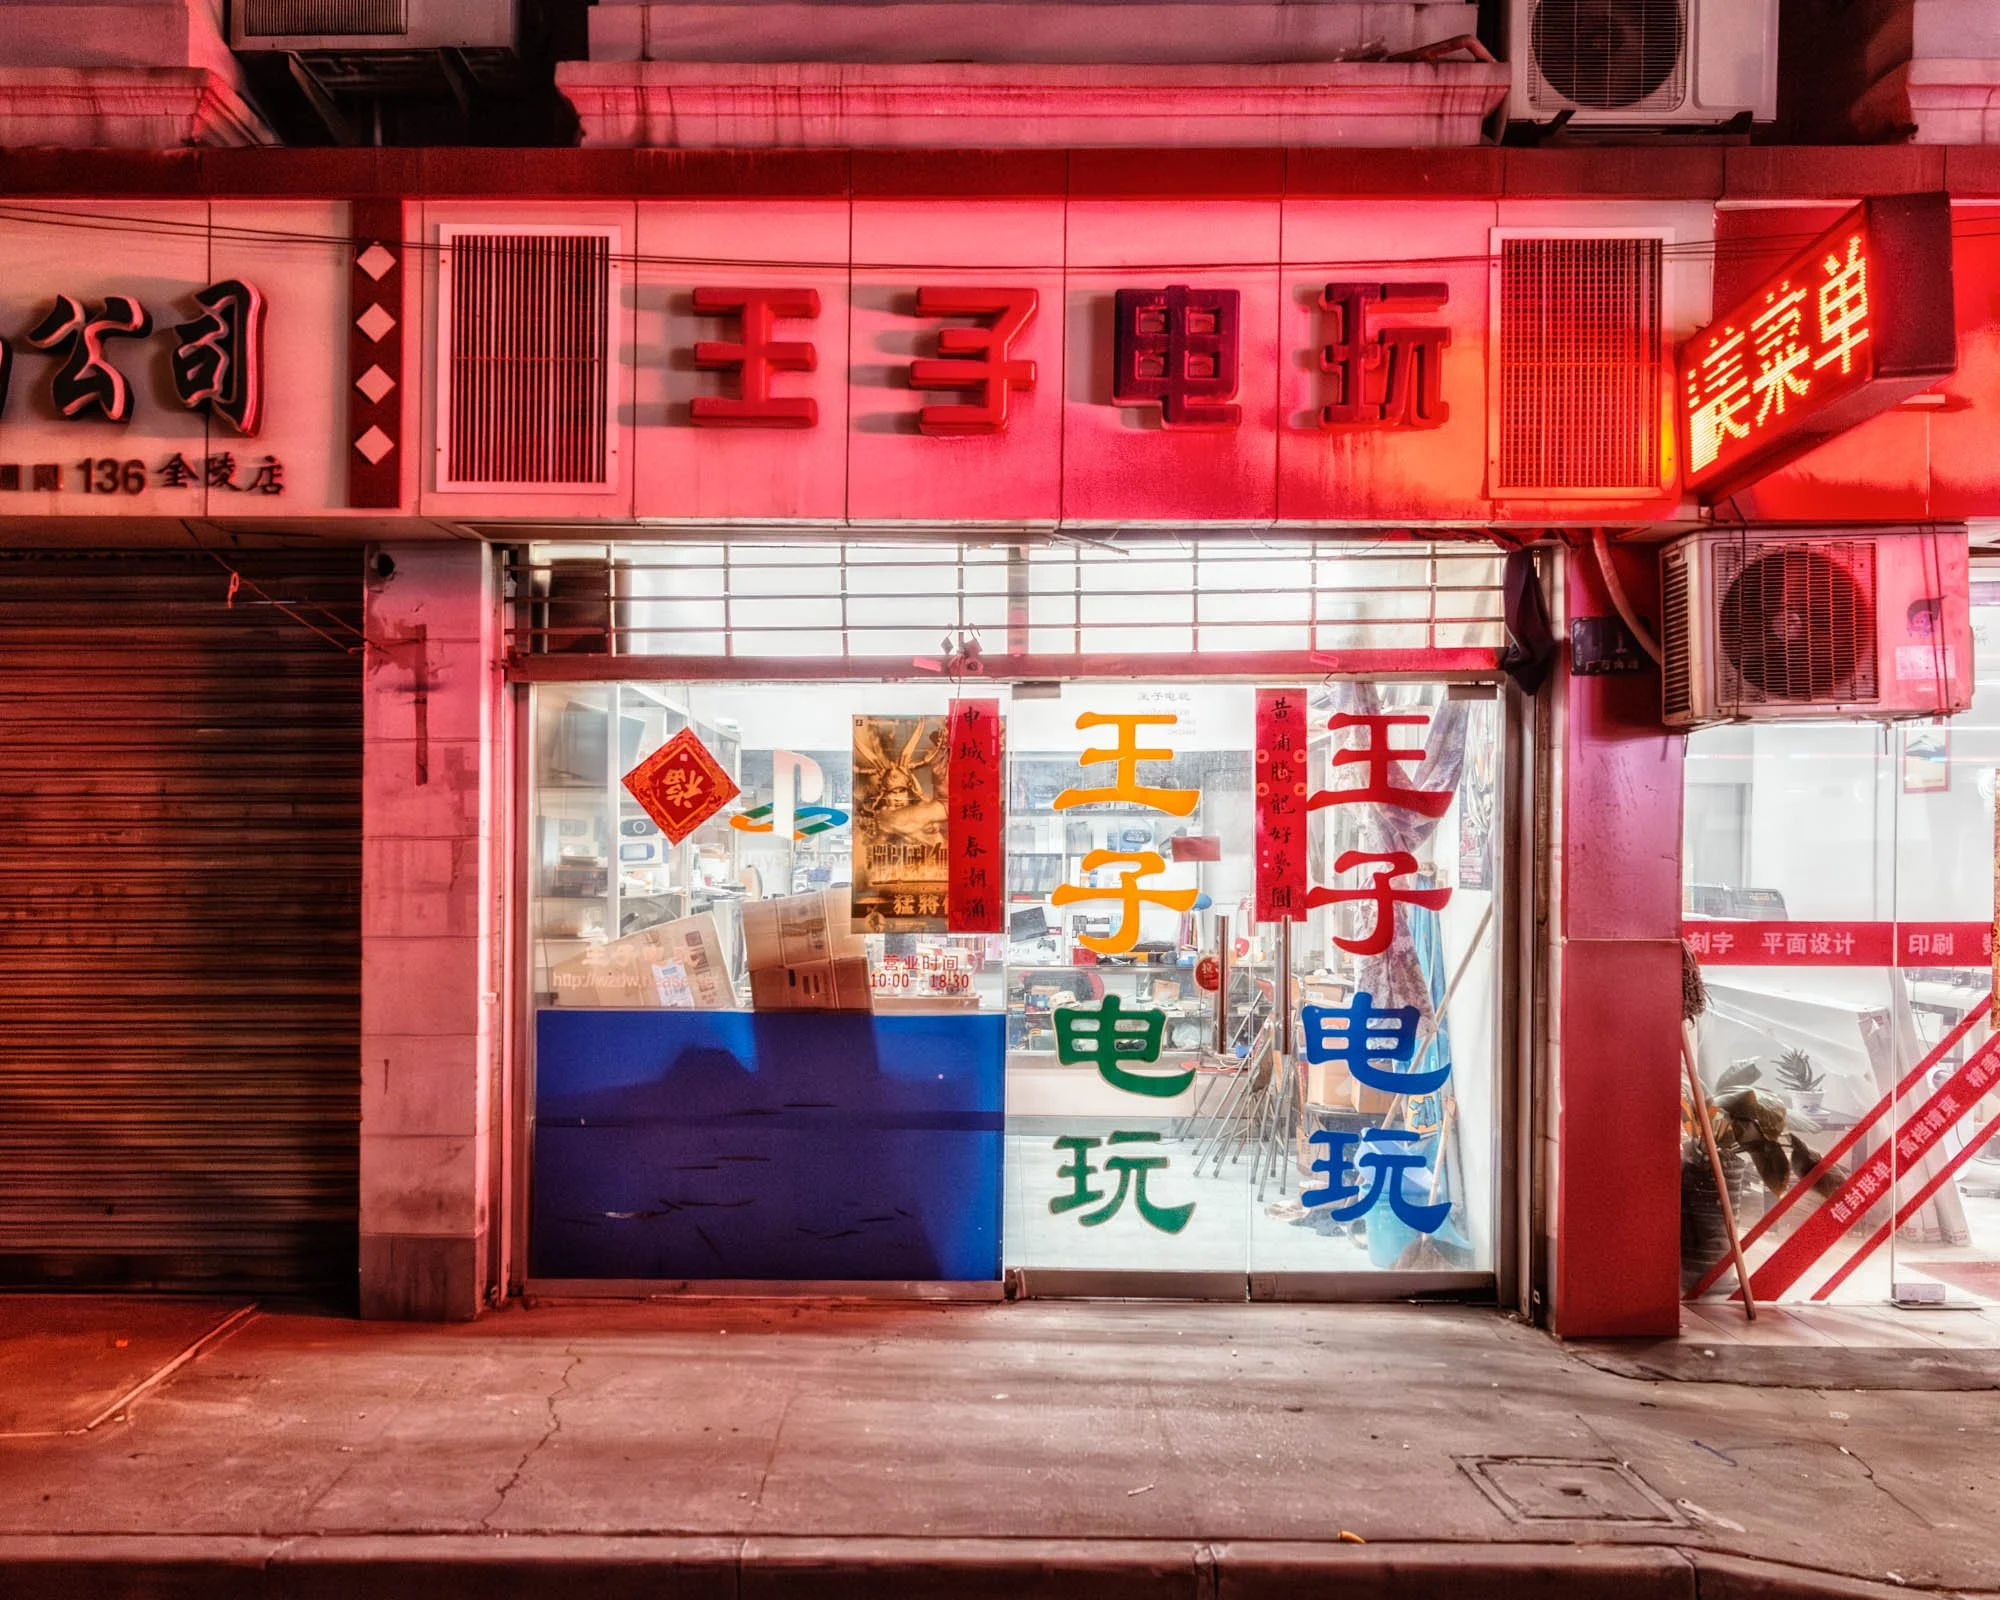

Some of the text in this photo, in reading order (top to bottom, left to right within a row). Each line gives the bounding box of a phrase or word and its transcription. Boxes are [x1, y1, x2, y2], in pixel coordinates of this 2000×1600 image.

[0, 280, 267, 437] 公司
[690, 282, 1450, 435] 王子电玩
[77, 457, 147, 494] 136
[884, 953, 958, 972] 营业时间
[1688, 931, 1735, 954] 刻字
[1762, 932, 1855, 956] 平面设计
[1908, 932, 1954, 956] 印刷
[871, 973, 969, 989] 10:00 18:30
[1897, 1094, 1960, 1159] 高档请柬
[1830, 1161, 1891, 1224] 信封联单
